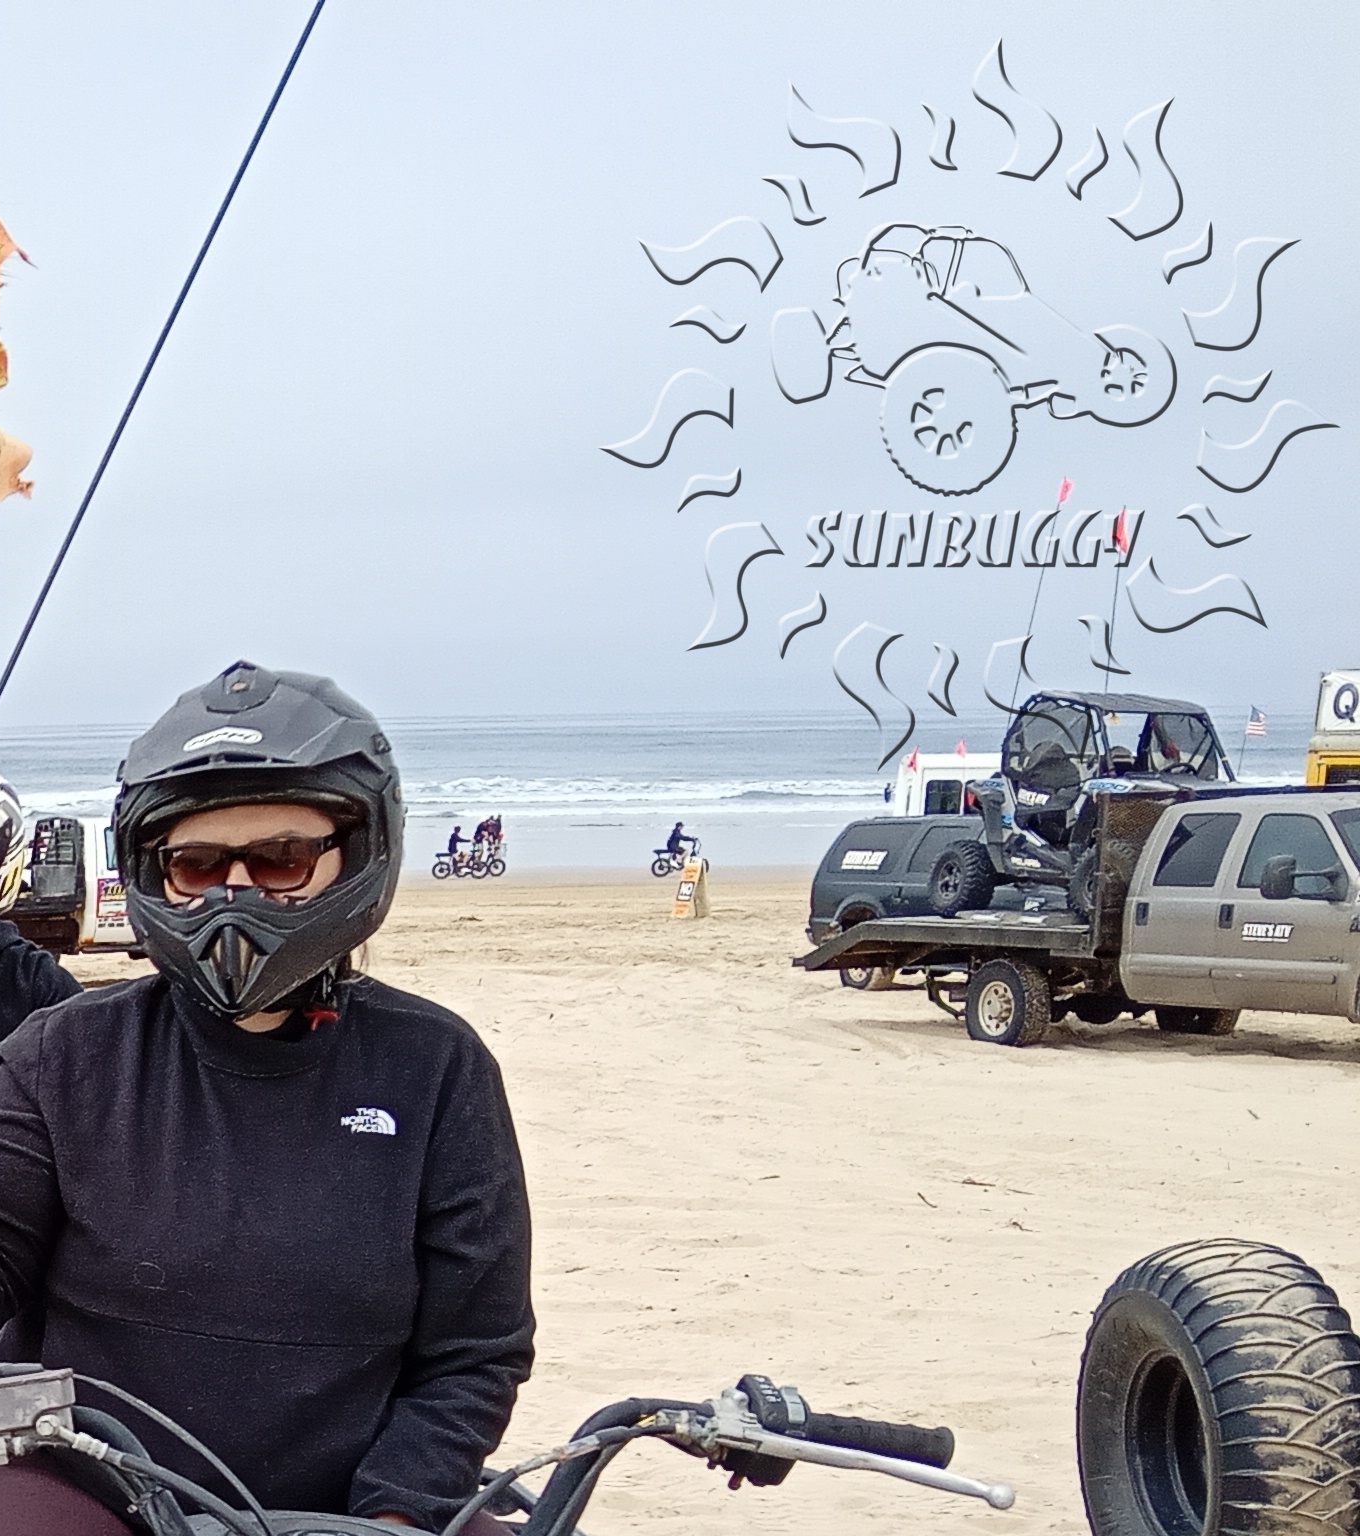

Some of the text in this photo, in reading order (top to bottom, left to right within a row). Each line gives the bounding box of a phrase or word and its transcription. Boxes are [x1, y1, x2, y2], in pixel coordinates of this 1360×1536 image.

[1242, 923, 1295, 938] STEVE'S ATV
[356, 1107, 378, 1117] THE
[341, 1115, 379, 1126] NORTH
[351, 1125, 379, 1134] FACE
